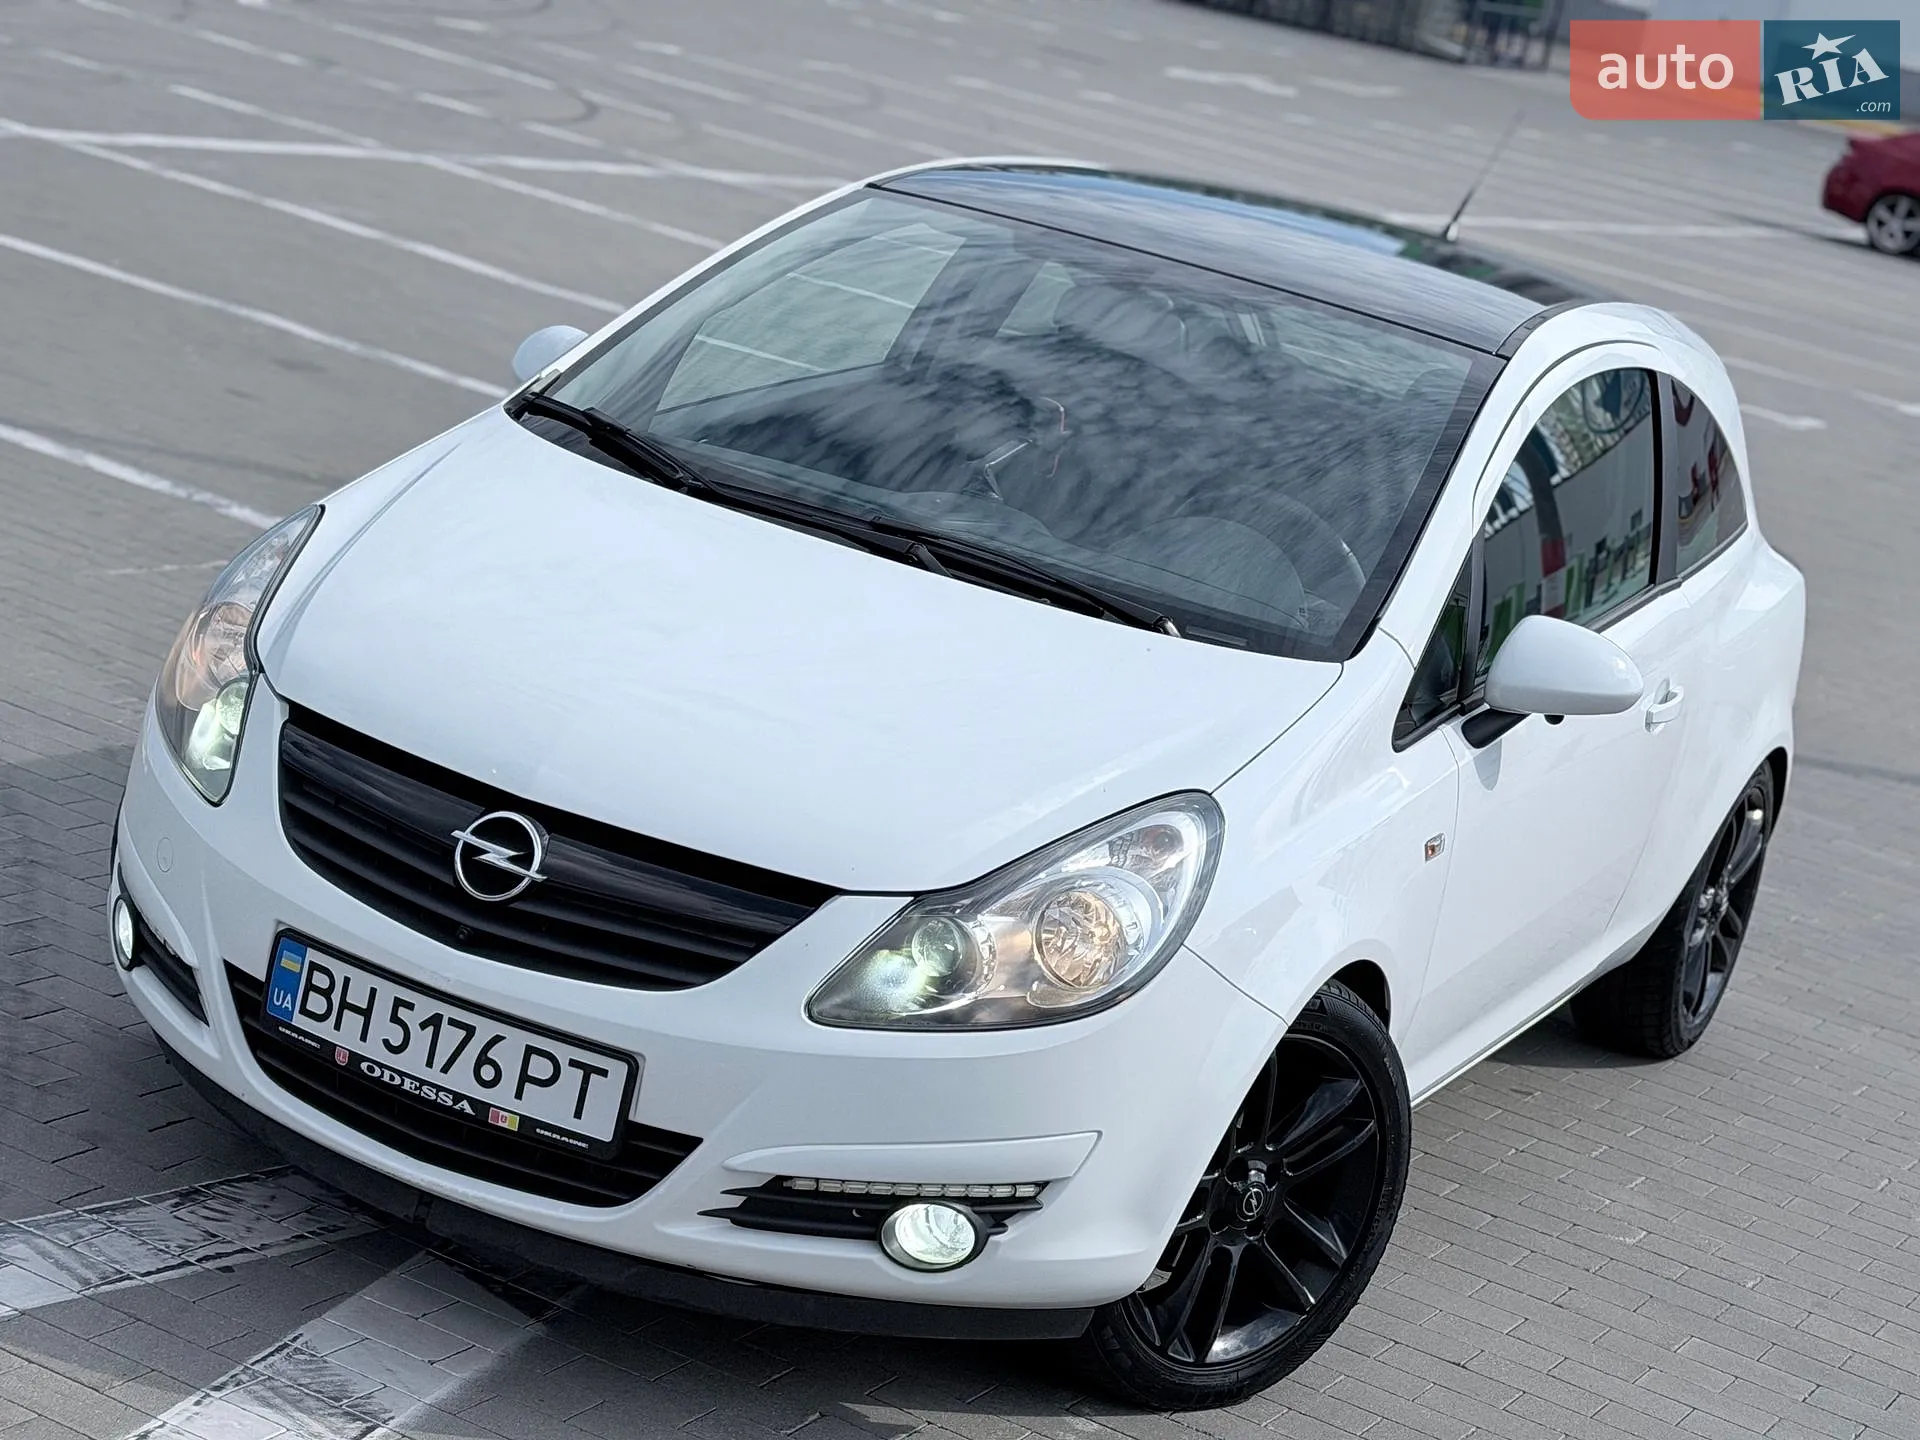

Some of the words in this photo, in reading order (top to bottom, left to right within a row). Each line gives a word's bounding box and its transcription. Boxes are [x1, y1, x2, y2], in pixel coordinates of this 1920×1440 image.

[273, 987, 293, 1011] UA
[298, 960, 377, 1043] BH
[382, 1002, 508, 1089] 5176
[514, 1045, 609, 1120] PT
[360, 1061, 476, 1116] ODESSA
